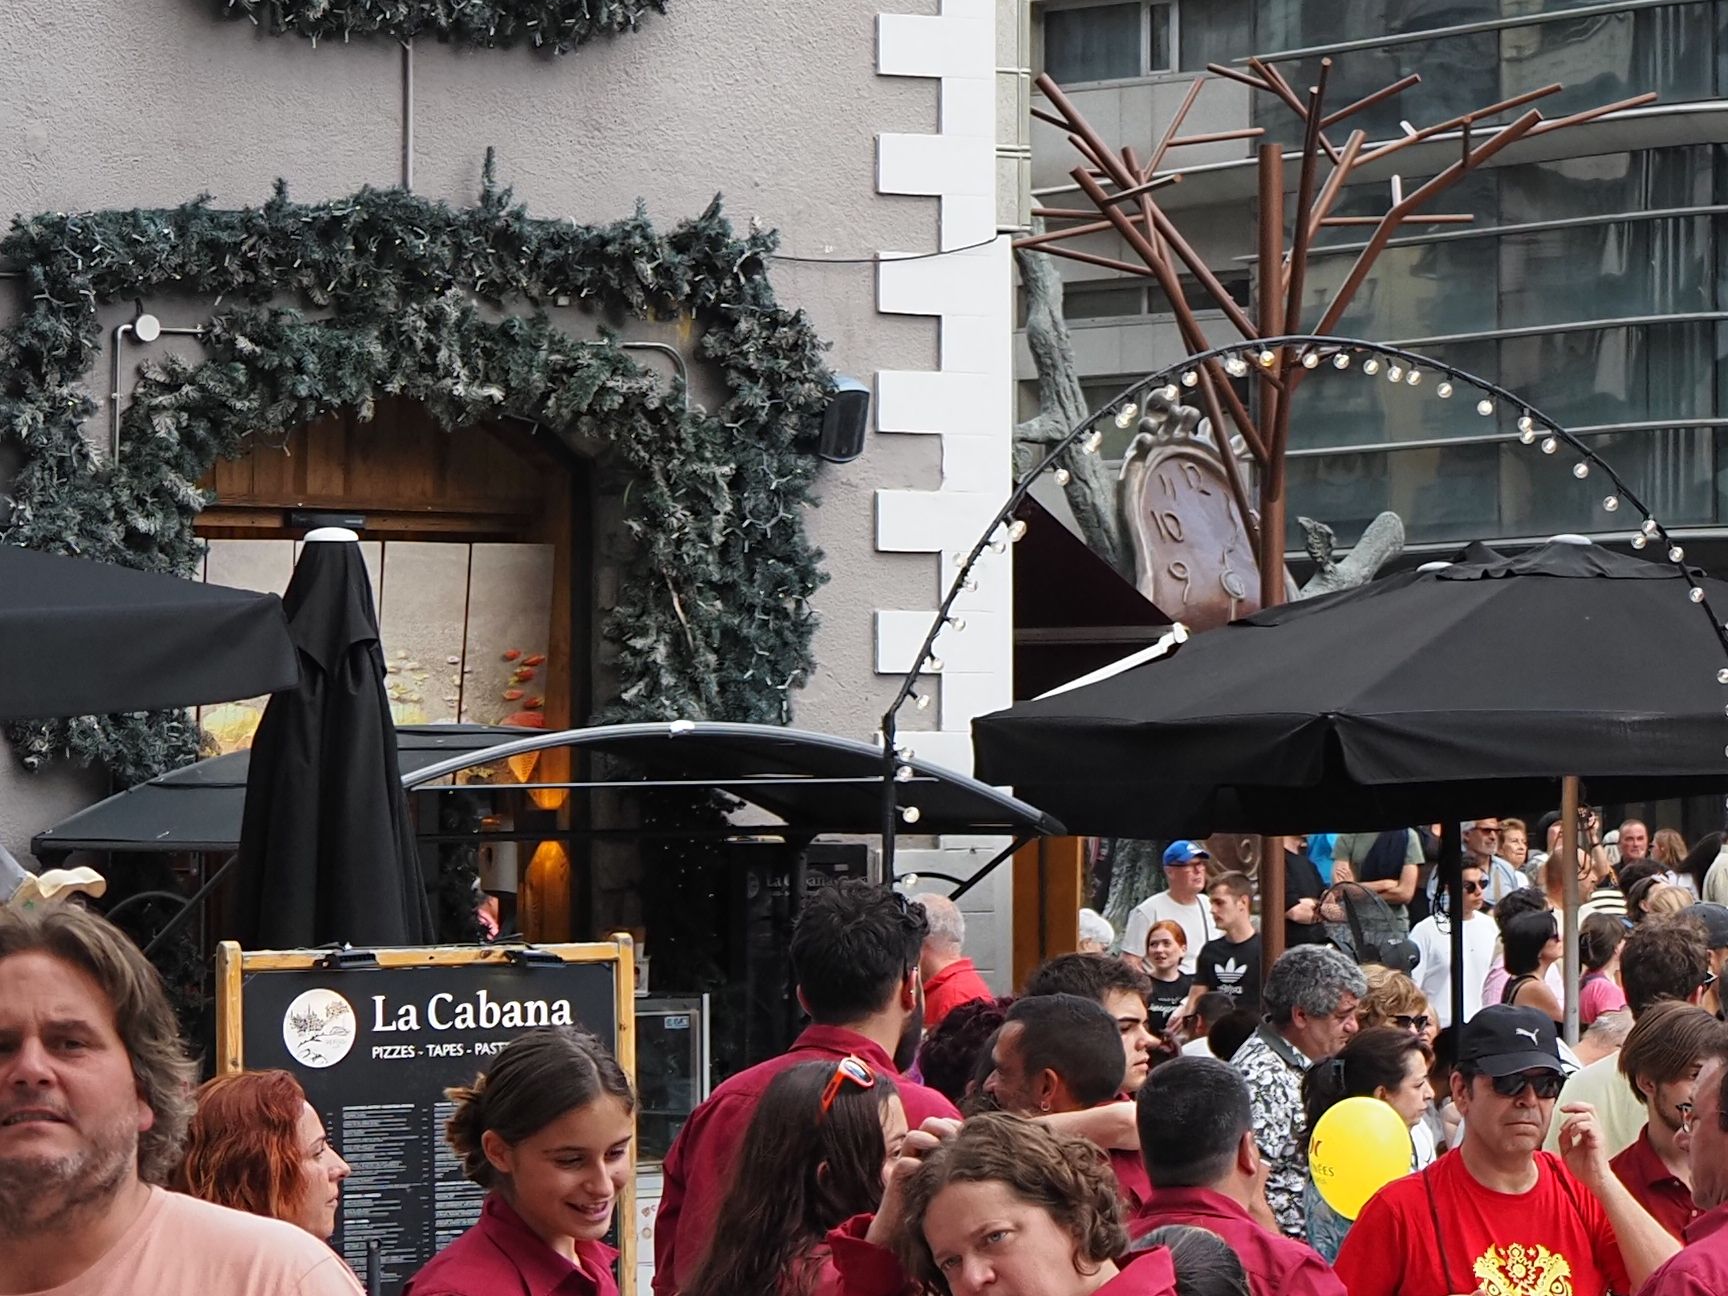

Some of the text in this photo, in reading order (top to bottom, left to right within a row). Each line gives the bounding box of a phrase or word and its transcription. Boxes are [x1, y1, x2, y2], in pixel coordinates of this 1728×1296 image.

[1150, 508, 1185, 545] 10
[370, 990, 574, 1032] La Cabana
[371, 1045, 416, 1060] PIZZES
[425, 1043, 464, 1057] TAPES
